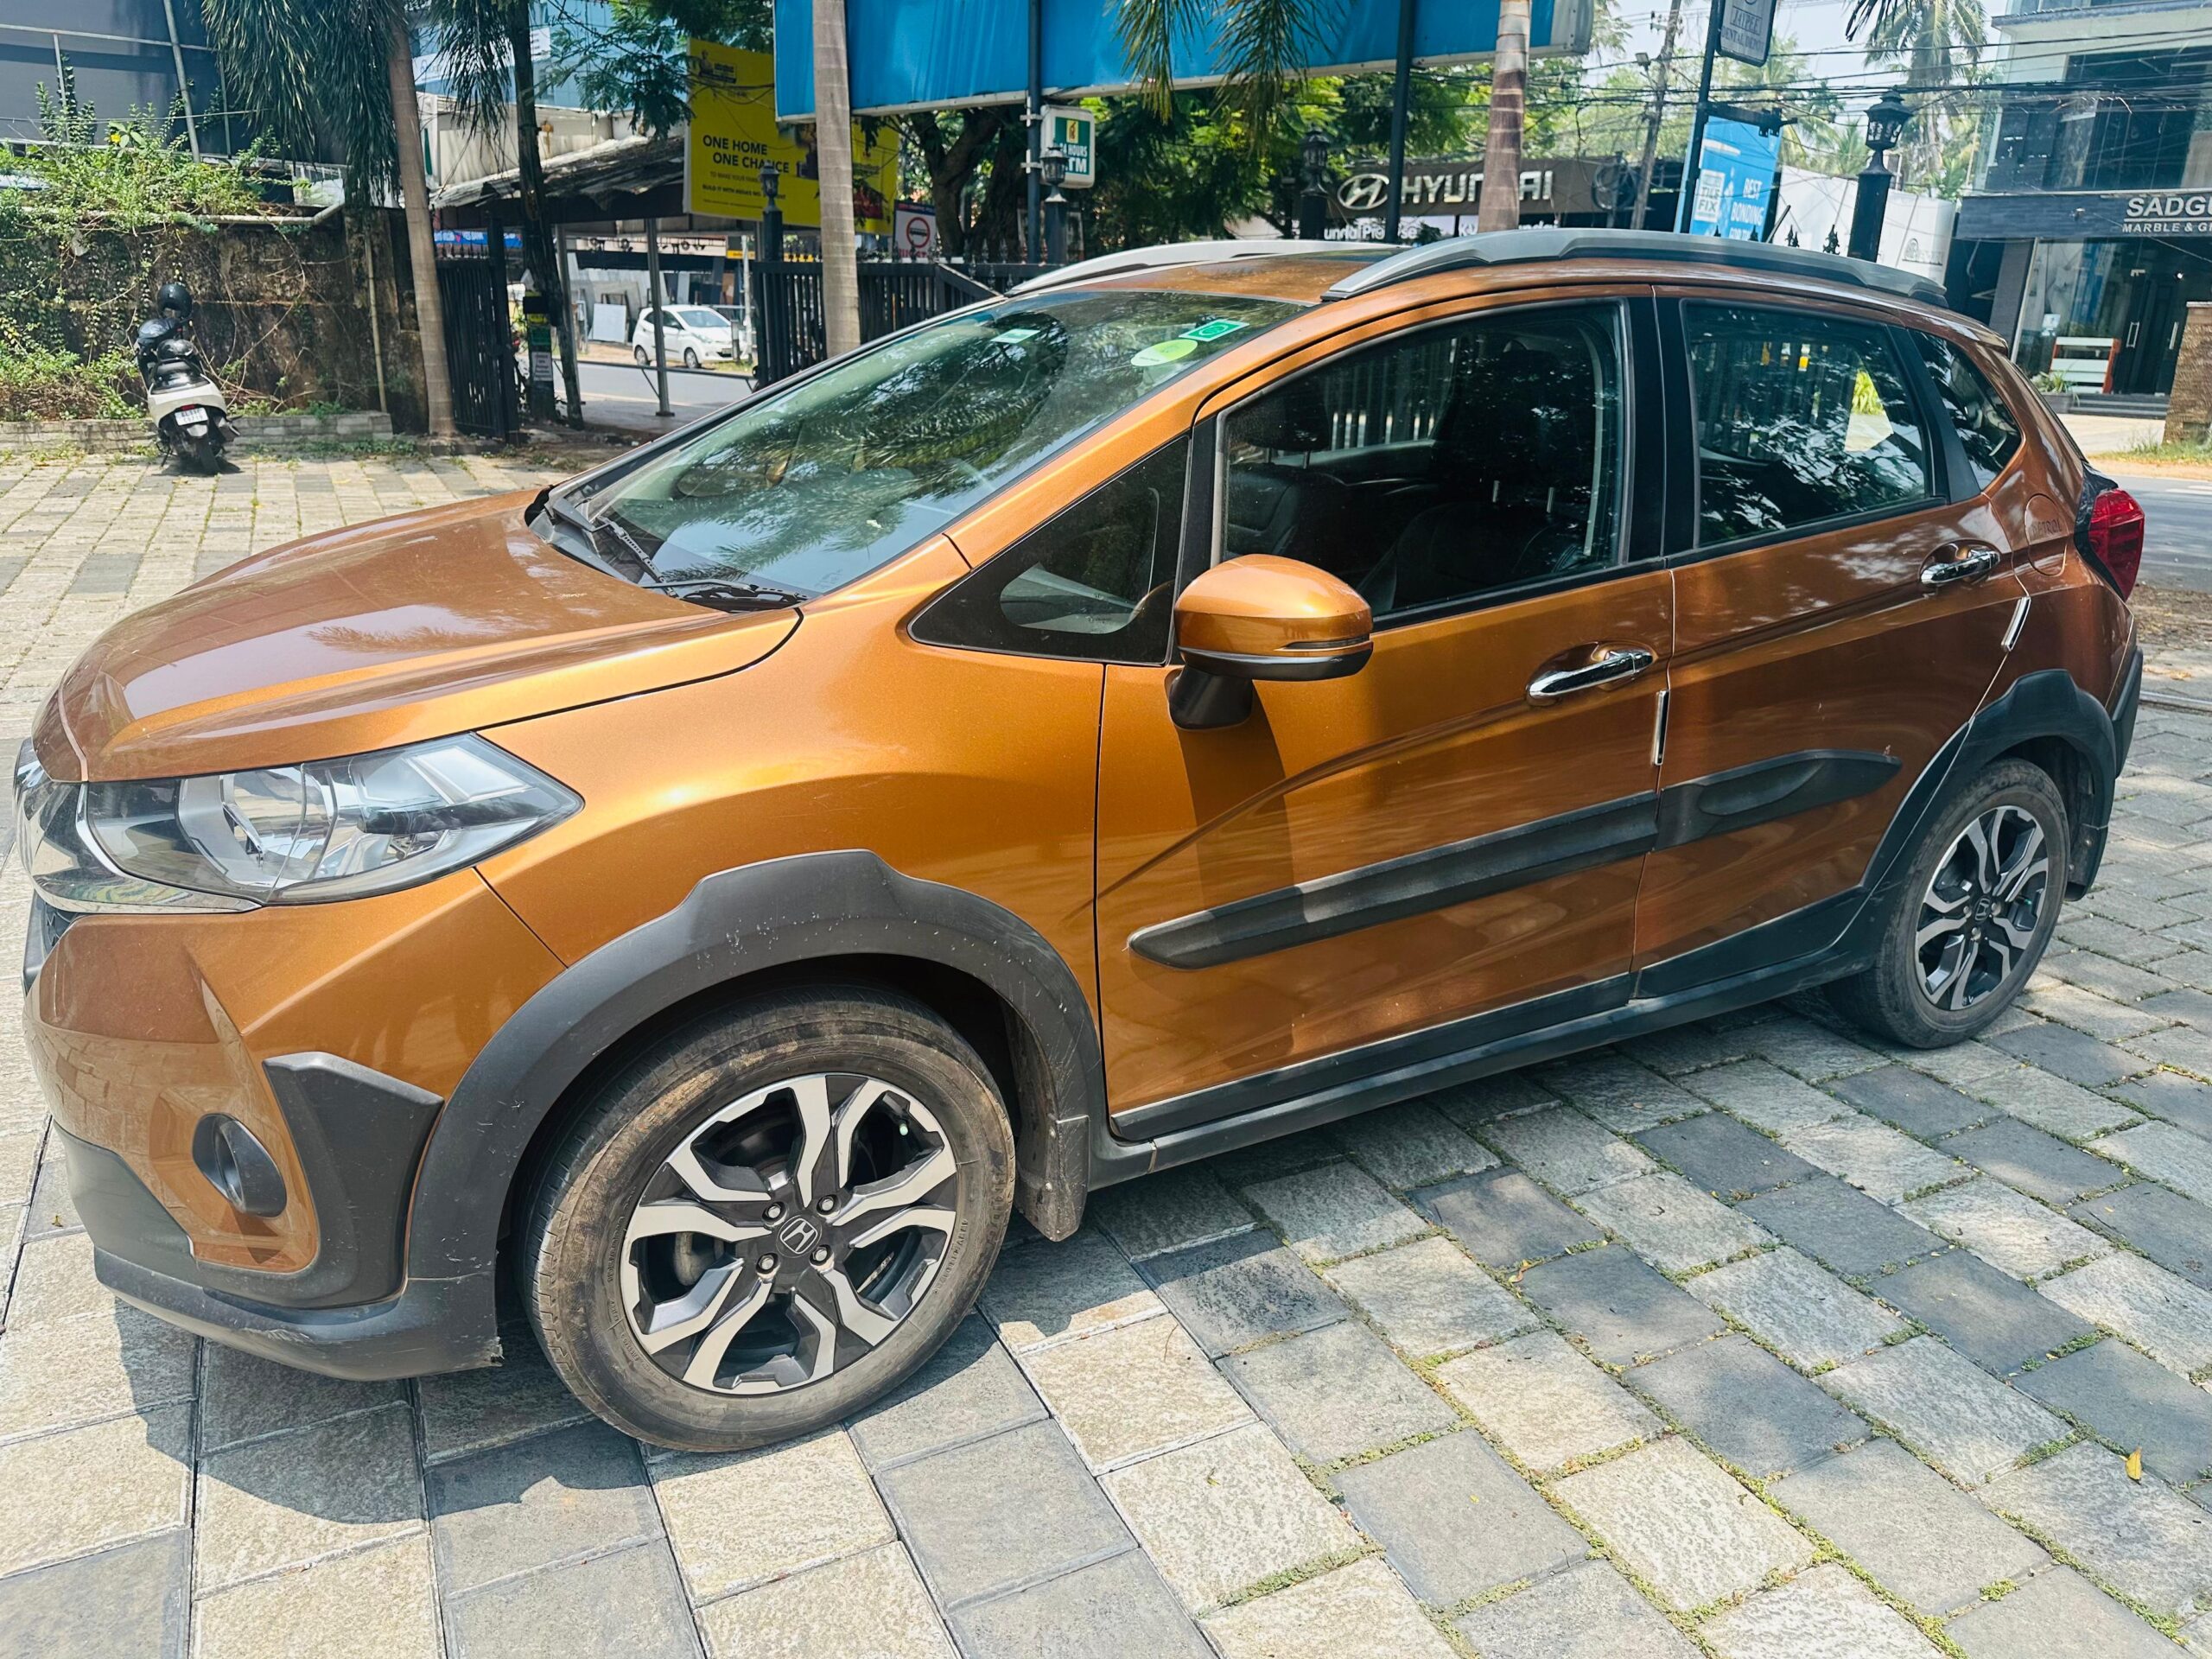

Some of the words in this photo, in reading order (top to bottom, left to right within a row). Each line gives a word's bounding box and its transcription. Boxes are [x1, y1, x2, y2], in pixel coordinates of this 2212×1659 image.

[702, 135, 729, 149] ONE
[733, 139, 767, 156] HOME
[1068, 144, 1088, 157] HOURS
[713, 152, 739, 167] ONE
[1065, 157, 1087, 173] TM
[1401, 170, 1554, 204] HYUNAI
[1701, 187, 1720, 199] TILE
[1744, 178, 1762, 200] BEST
[1698, 199, 1718, 213] FIX
[1731, 201, 1764, 226] BONDING
[2126, 195, 2212, 217] SADG
[2122, 222, 2180, 233] MARBLE
[2184, 222, 2193, 232] &
[2197, 222, 2212, 232] G
